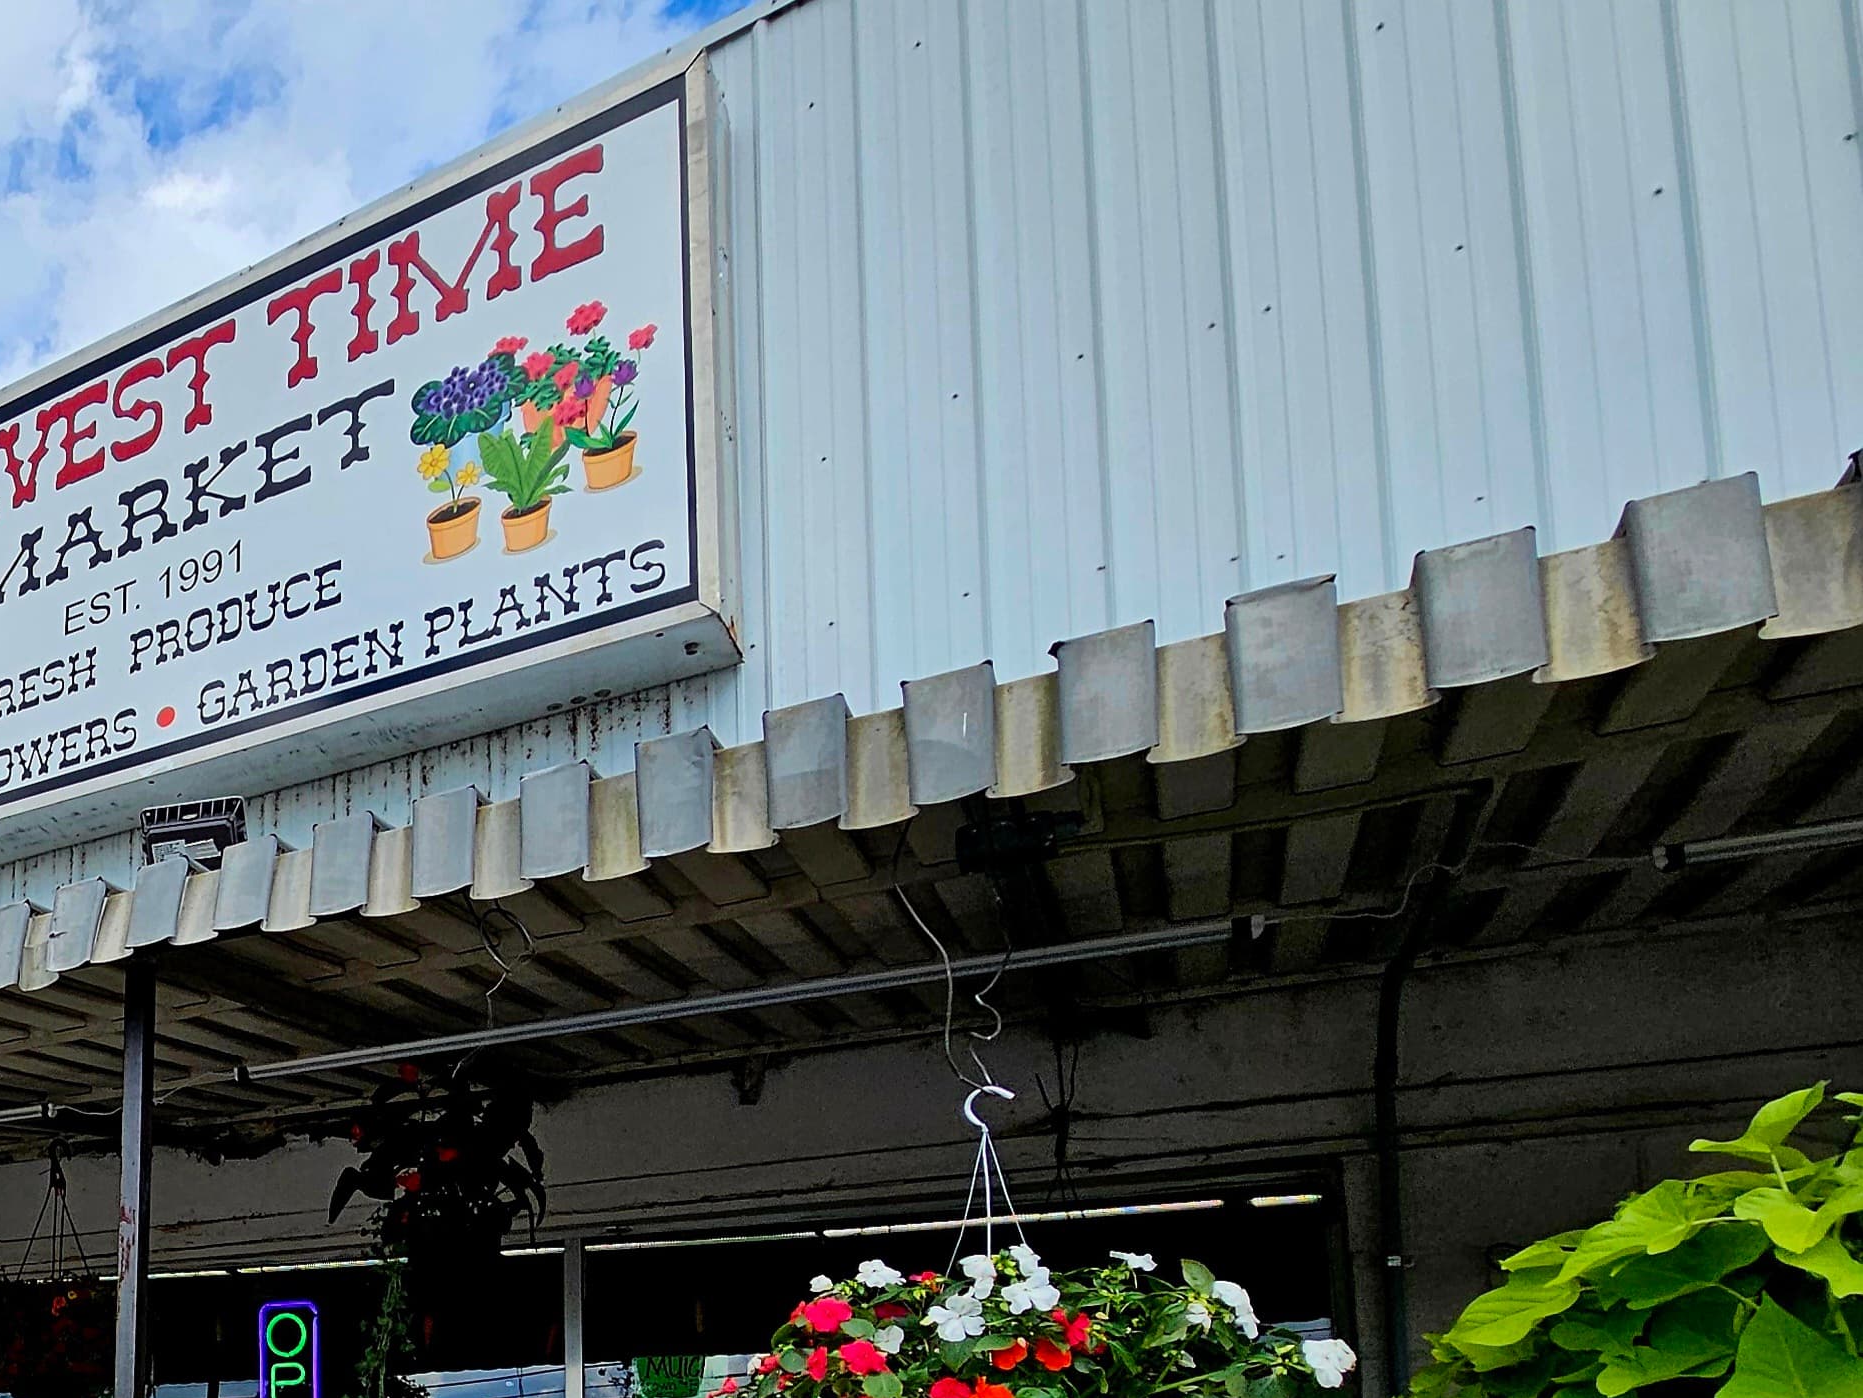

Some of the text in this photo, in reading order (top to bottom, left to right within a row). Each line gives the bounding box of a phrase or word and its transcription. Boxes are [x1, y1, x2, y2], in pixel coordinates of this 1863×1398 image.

[268, 144, 605, 388] TIME
[64, 538, 242, 636] EST. 1991
[129, 559, 343, 675] PRODUCE
[197, 620, 404, 725] GARDEN
[424, 539, 666, 659] PLANTS
